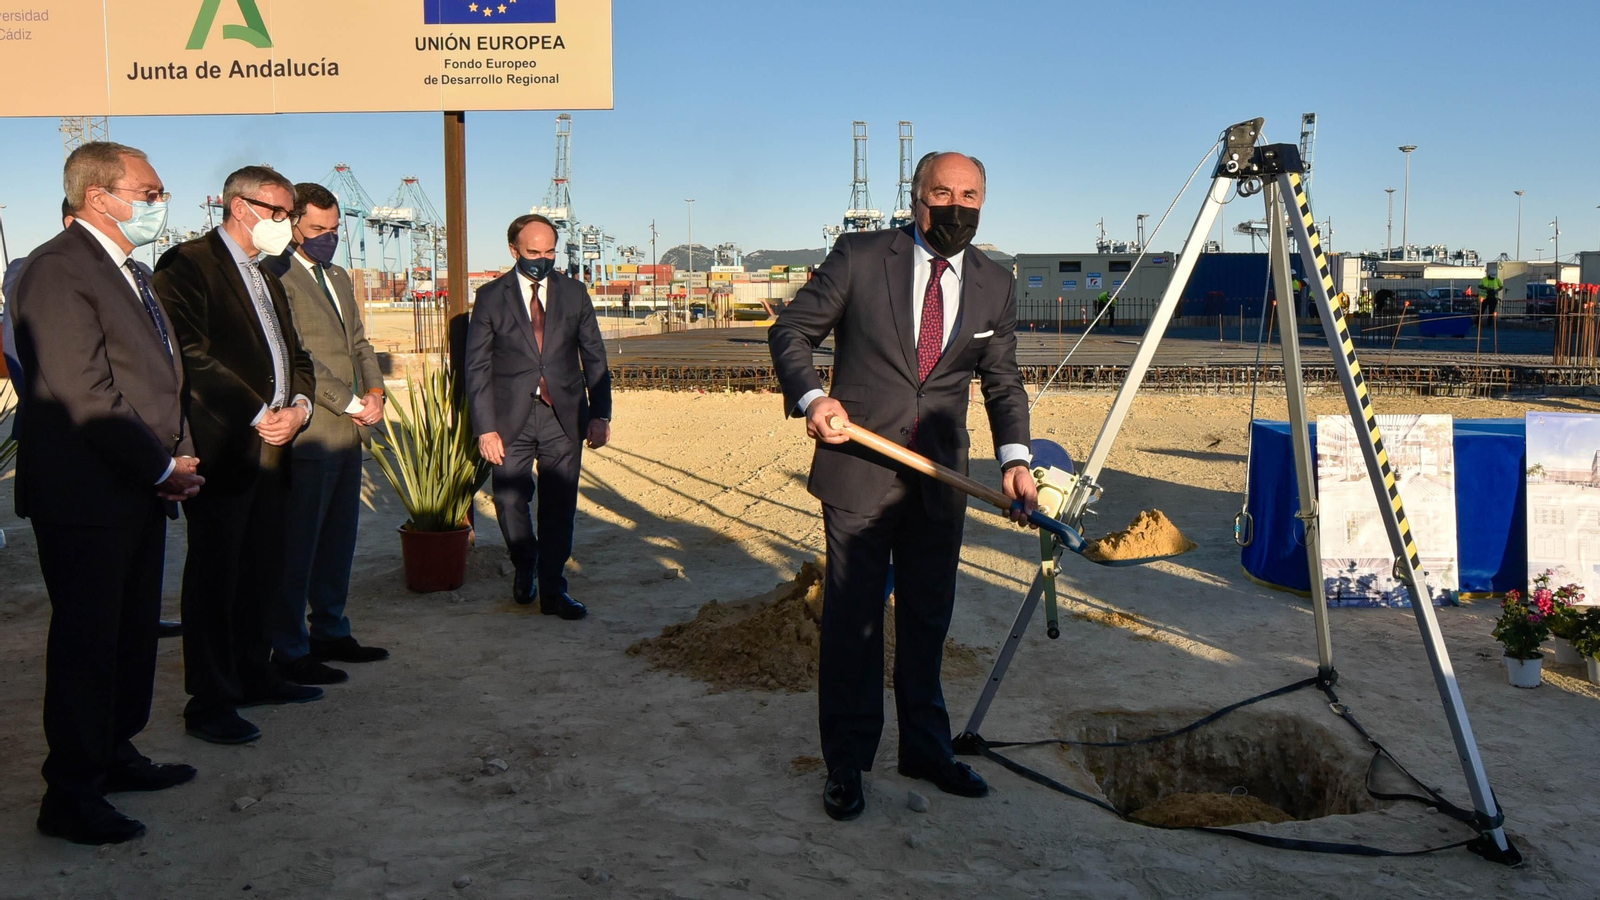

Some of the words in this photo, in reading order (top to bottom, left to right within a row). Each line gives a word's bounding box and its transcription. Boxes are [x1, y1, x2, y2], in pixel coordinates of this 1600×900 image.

[415, 33, 471, 51] UNIÓN
[477, 35, 566, 51] EUROPEA
[126, 62, 188, 81] Junta
[195, 61, 222, 79] de
[228, 58, 340, 79] Andalucía
[444, 58, 482, 69] Fondo
[486, 58, 537, 70] Europeo
[424, 75, 438, 86] de
[441, 74, 503, 86] Desarrollo
[506, 73, 560, 87] Regional
